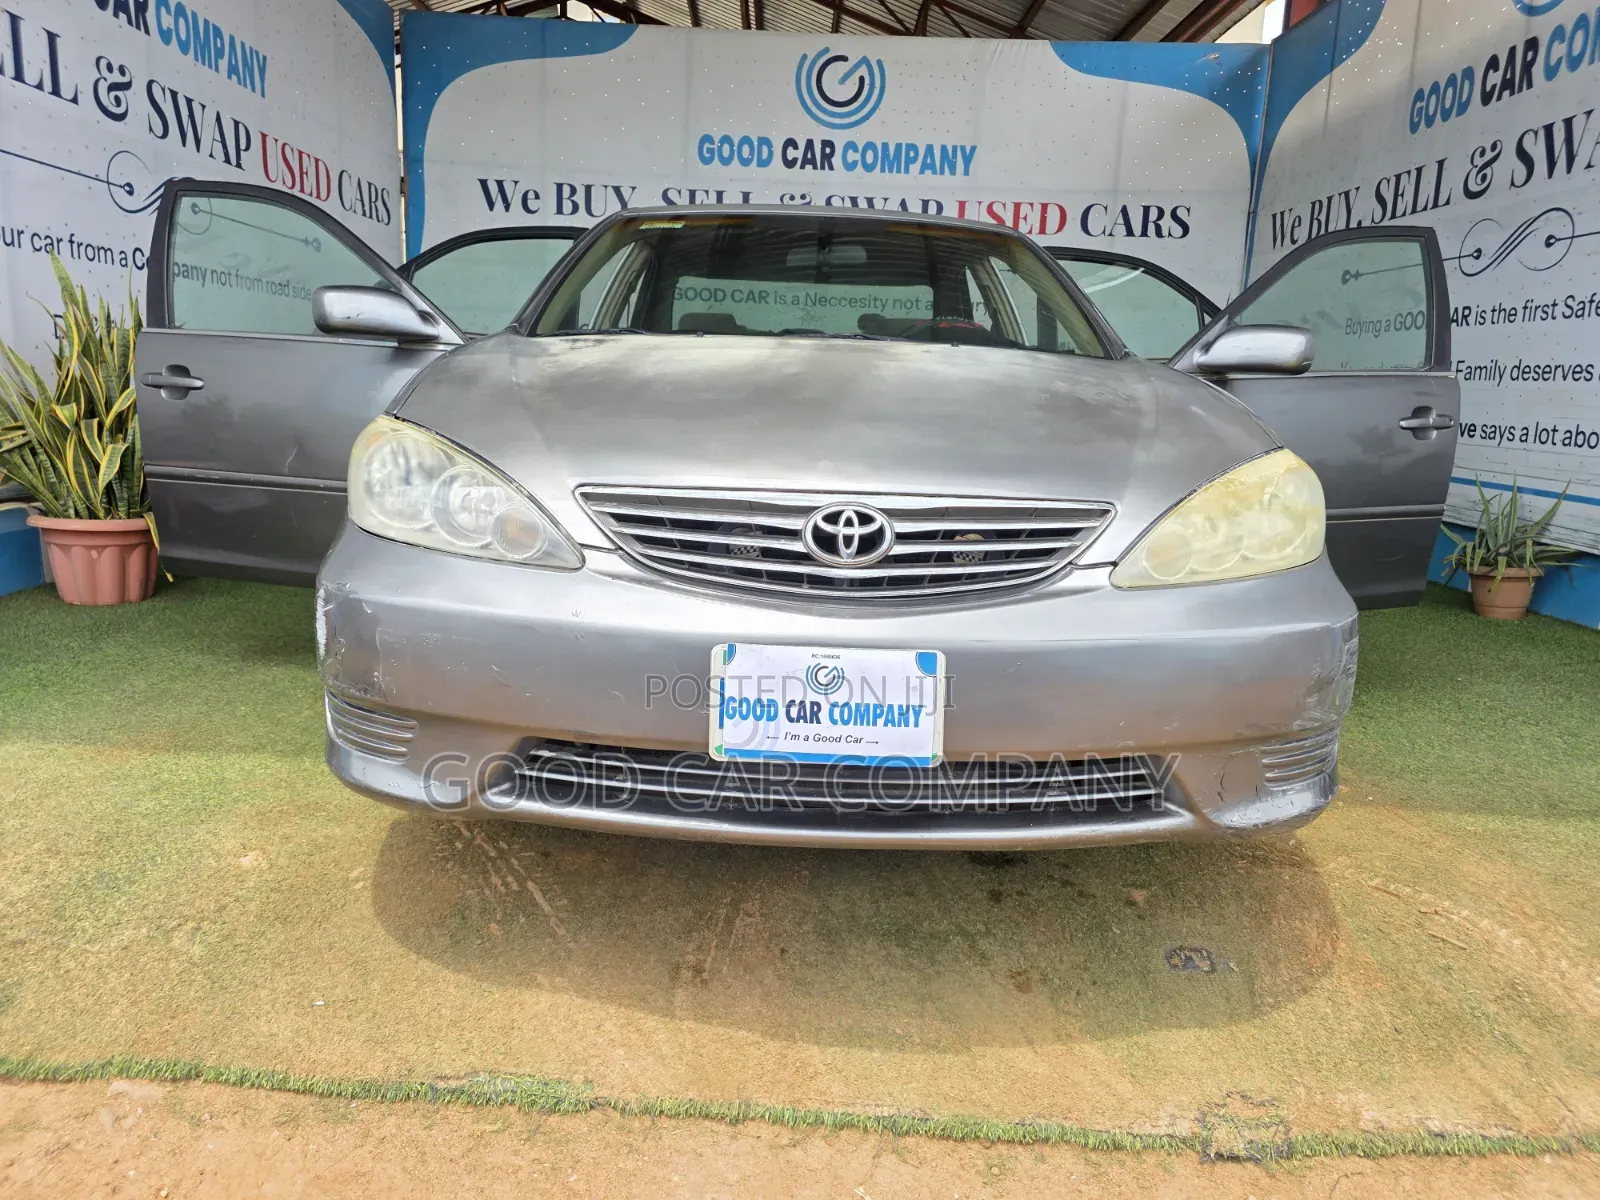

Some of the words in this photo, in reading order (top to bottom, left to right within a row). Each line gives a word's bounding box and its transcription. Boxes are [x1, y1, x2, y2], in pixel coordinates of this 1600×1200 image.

[94, 0, 151, 37] AR
[155, 0, 268, 99] COMPANY
[1409, 66, 1475, 135] GOOD
[1480, 36, 1540, 107] CAR
[0, 9, 79, 106] LL
[93, 55, 133, 122] &
[146, 79, 252, 171] SWAP
[258, 131, 332, 203] USED
[338, 169, 392, 226] CARS
[697, 134, 774, 168] GOOD
[781, 138, 836, 171] CAR
[841, 140, 978, 177] COMPANY
[477, 178, 541, 215] We
[956, 200, 1068, 236] USED
[1079, 203, 1191, 239] CARS
[1271, 207, 1302, 250] We
[1371, 157, 1452, 225] SELL
[1462, 139, 1503, 200] &
[0, 226, 25, 249] ur
[31, 233, 63, 256] car
[68, 233, 115, 266] from
[119, 250, 129, 268] a
[211, 269, 233, 288] not
[234, 269, 264, 294] from
[265, 280, 290, 298] road
[673, 286, 727, 302] GOOD
[731, 288, 770, 304] CAR
[773, 290, 787, 305] is
[791, 294, 800, 307] a
[804, 291, 889, 312] Neccesity
[892, 297, 921, 311] not
[924, 300, 933, 311] a
[1345, 317, 1382, 338] Buying
[1384, 318, 1391, 332] a
[1394, 309, 1427, 332] GOO
[1450, 305, 1472, 327] AR
[1474, 304, 1487, 326] is
[1490, 302, 1518, 325] the
[1522, 298, 1558, 323] first
[1456, 359, 1507, 387] Family
[1510, 358, 1595, 382] deserves
[1480, 424, 1516, 446] says
[1519, 426, 1529, 443] a
[1534, 421, 1558, 446] lot
[725, 696, 779, 722] GOOD
[785, 699, 822, 724] CAR
[828, 701, 923, 728] COMPANY
[784, 731, 800, 742] I'm
[803, 734, 809, 742] a
[812, 733, 842, 744] Good
[845, 734, 864, 745] Car
